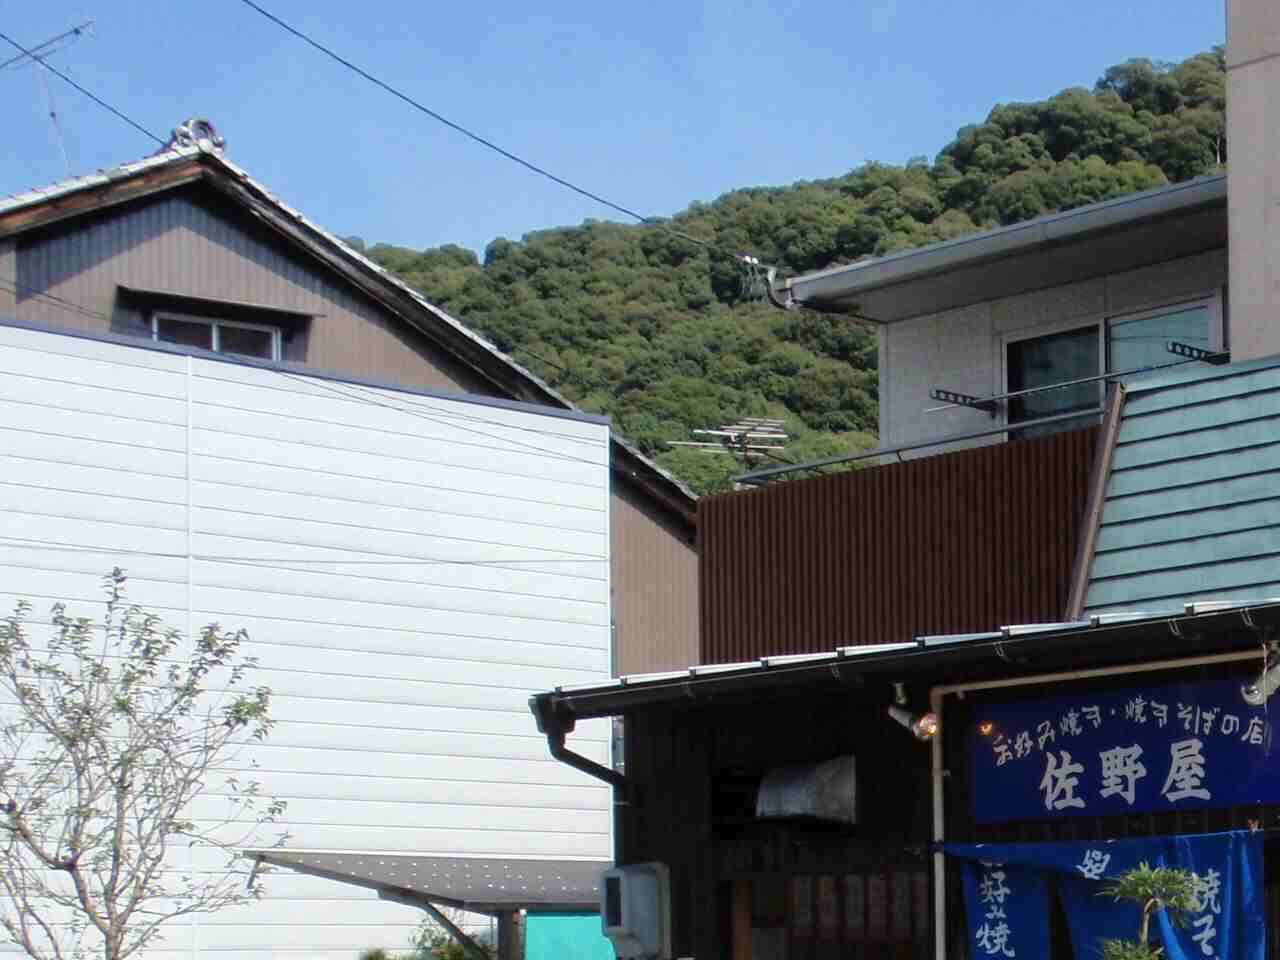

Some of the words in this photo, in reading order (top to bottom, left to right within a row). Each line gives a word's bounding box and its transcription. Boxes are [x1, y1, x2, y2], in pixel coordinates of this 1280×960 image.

[1039, 738, 1211, 810] 佐野屋
[976, 860, 1016, 958] 好み焼
